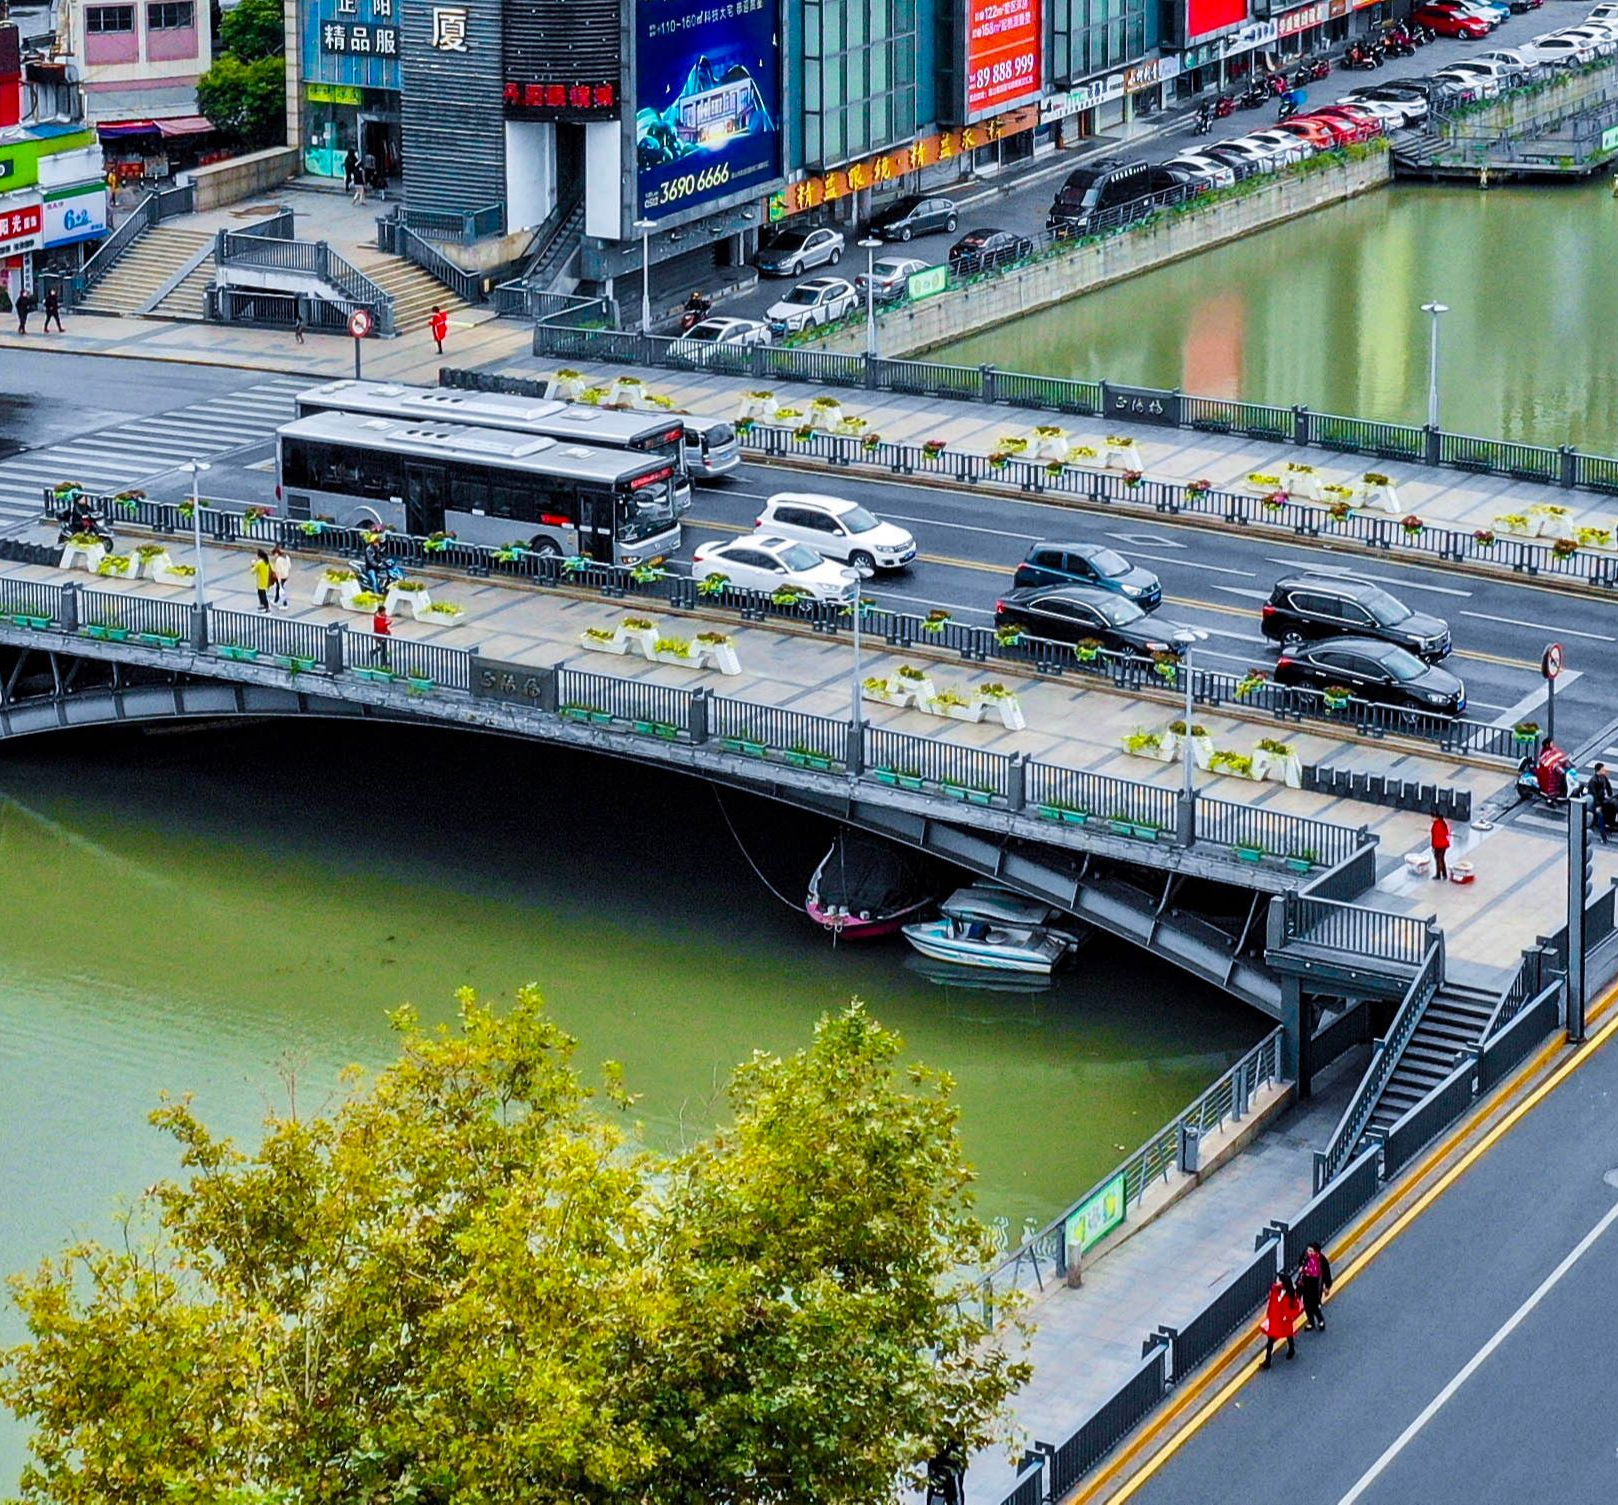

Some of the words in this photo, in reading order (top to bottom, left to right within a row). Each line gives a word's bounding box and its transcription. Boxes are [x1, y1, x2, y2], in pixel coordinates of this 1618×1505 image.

[323, 23, 397, 55] 精品服
[976, 66, 991, 89] 89
[992, 60, 1013, 84] 888
[1014, 53, 1035, 77] 999
[659, 174, 695, 205] 3690
[696, 161, 730, 192] 6666
